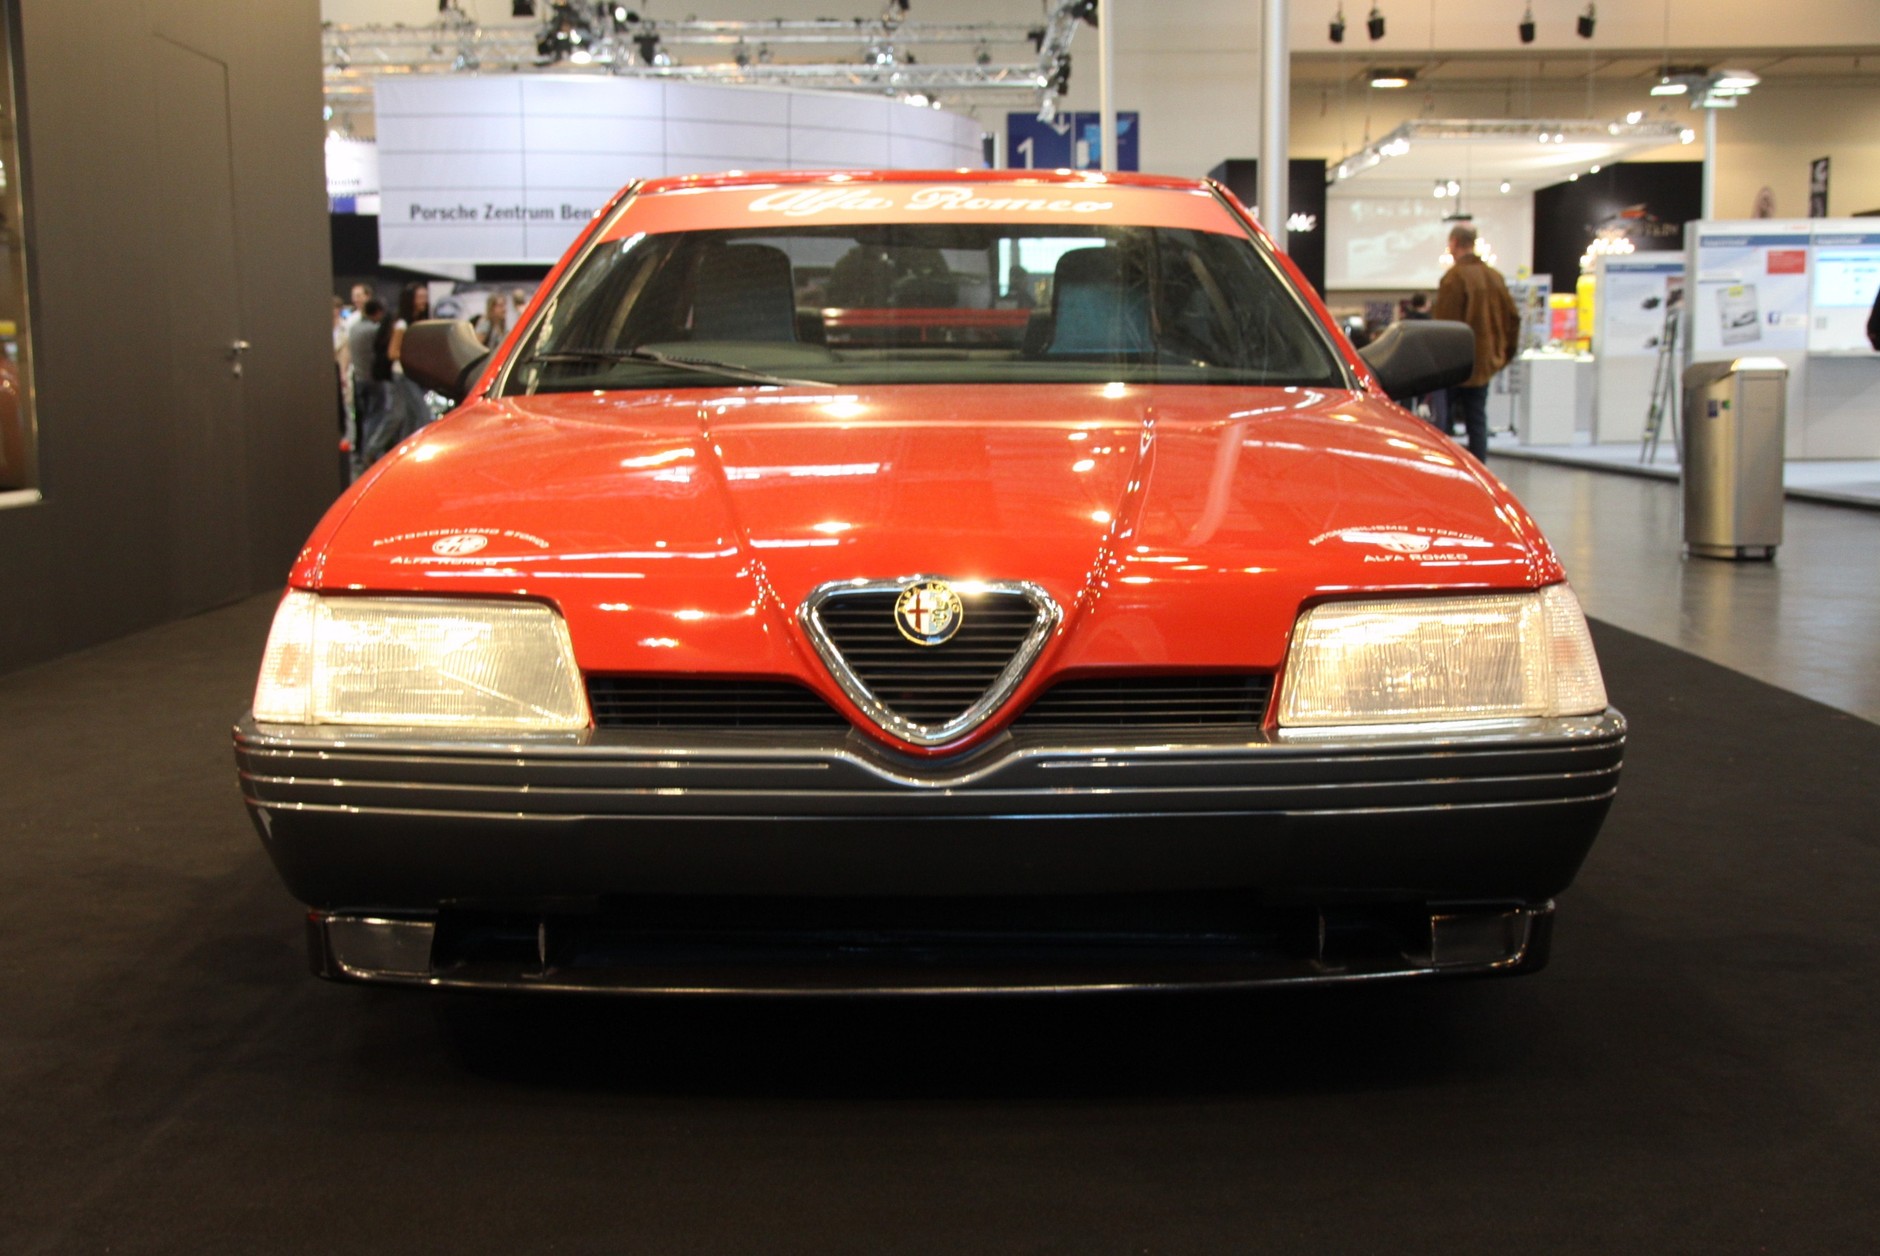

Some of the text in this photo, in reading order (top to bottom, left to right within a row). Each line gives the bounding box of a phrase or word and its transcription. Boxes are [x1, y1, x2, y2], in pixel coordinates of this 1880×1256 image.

[748, 186, 1113, 217] Alfa Romeo
[409, 203, 478, 221] Porsche
[484, 203, 555, 221] Zentrum
[1363, 553, 1468, 563] ALFA ROMEO
